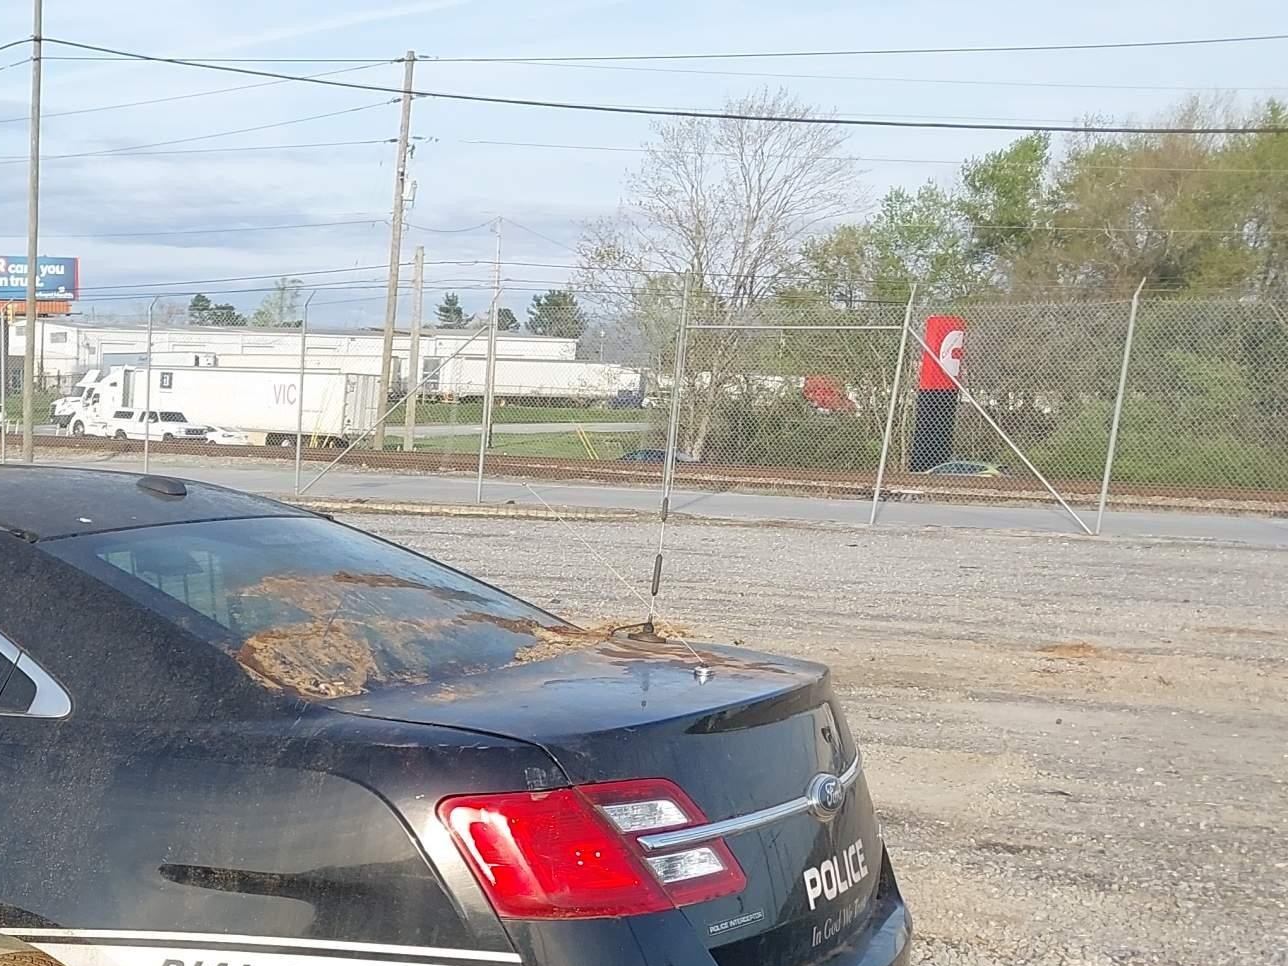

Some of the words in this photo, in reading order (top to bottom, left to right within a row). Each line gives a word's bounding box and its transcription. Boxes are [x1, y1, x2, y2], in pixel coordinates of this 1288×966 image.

[8, 263, 31, 274] car
[40, 264, 65, 277] you
[9, 275, 44, 287] trut.
[273, 383, 297, 405] VIC
[824, 781, 843, 808] Ford
[803, 838, 870, 911] POLICE
[709, 921, 729, 934] POLICE
[812, 925, 822, 947] In
[823, 909, 842, 940] God
